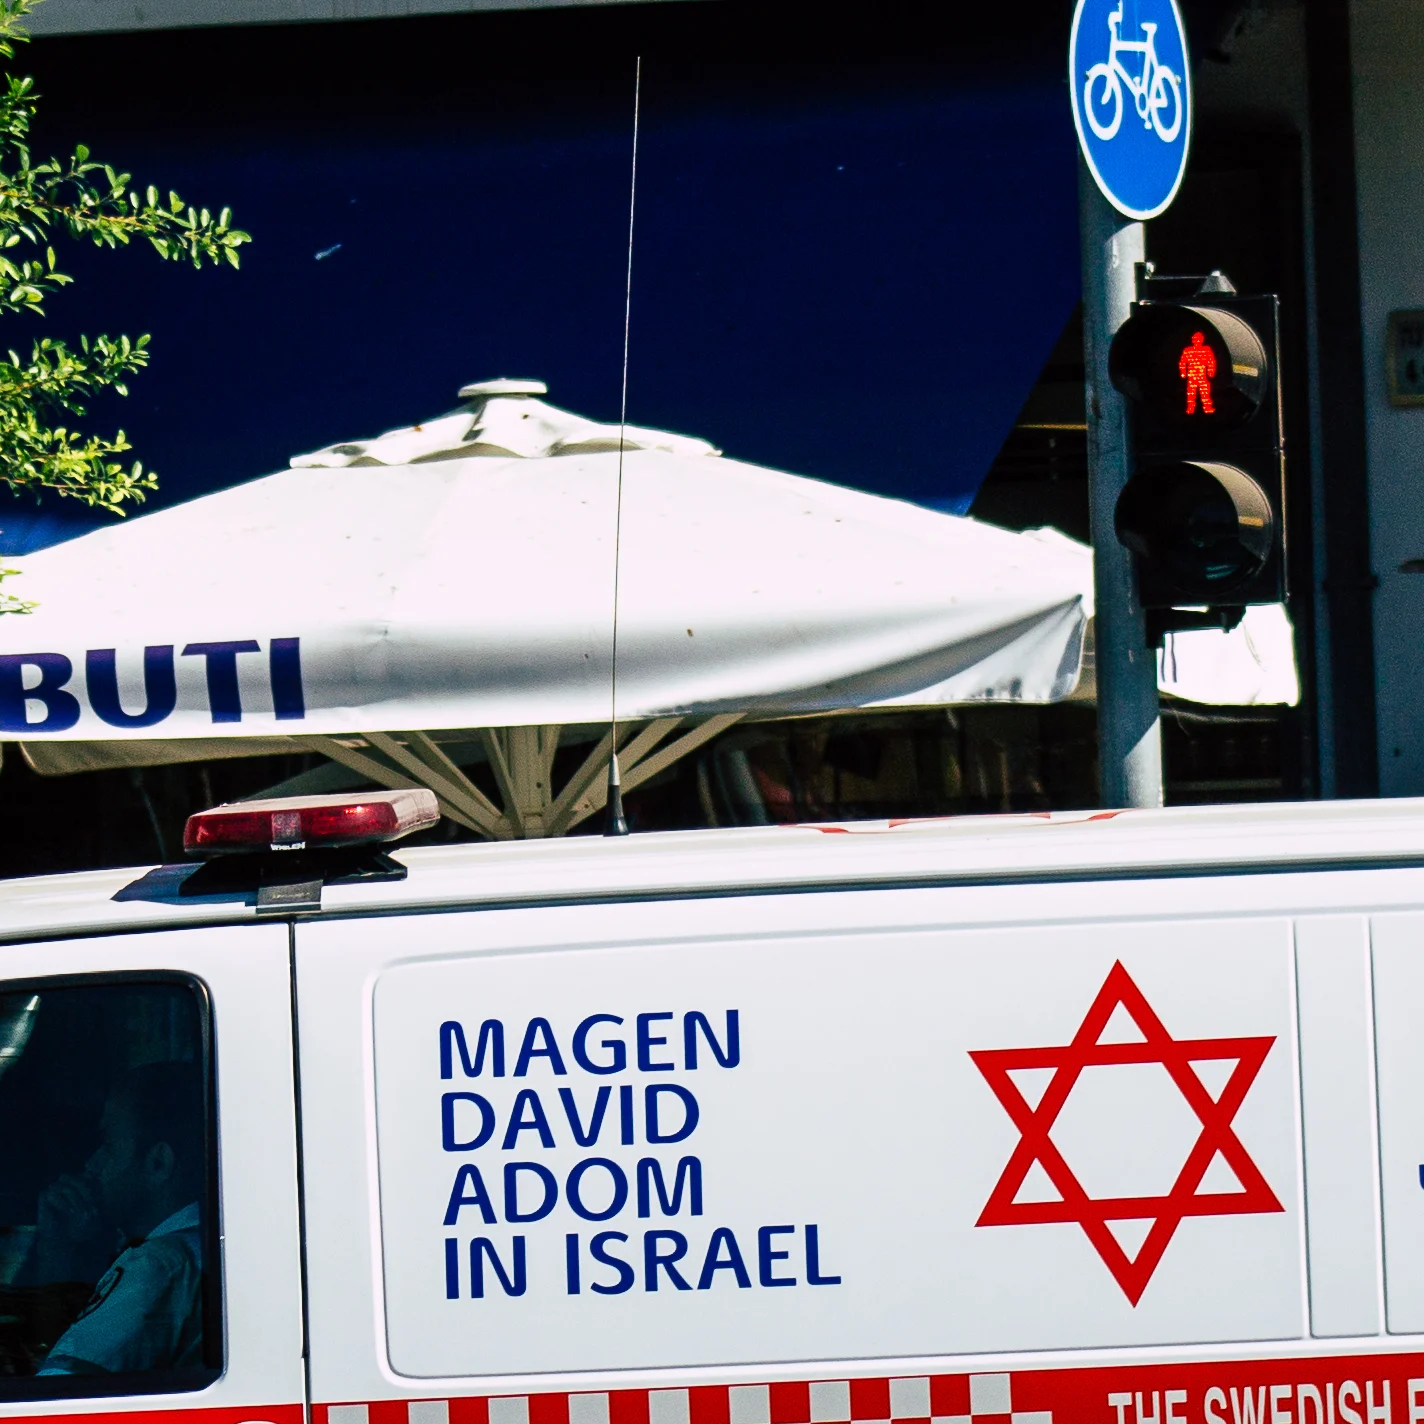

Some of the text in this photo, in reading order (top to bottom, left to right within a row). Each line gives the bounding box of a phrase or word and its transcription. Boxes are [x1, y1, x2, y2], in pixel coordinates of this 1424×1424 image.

[439, 1009, 740, 1080] MAGEN
[441, 1083, 700, 1152] DAVID
[442, 1155, 703, 1226] ADOM
[444, 1224, 842, 1300] IN ISRAEL
